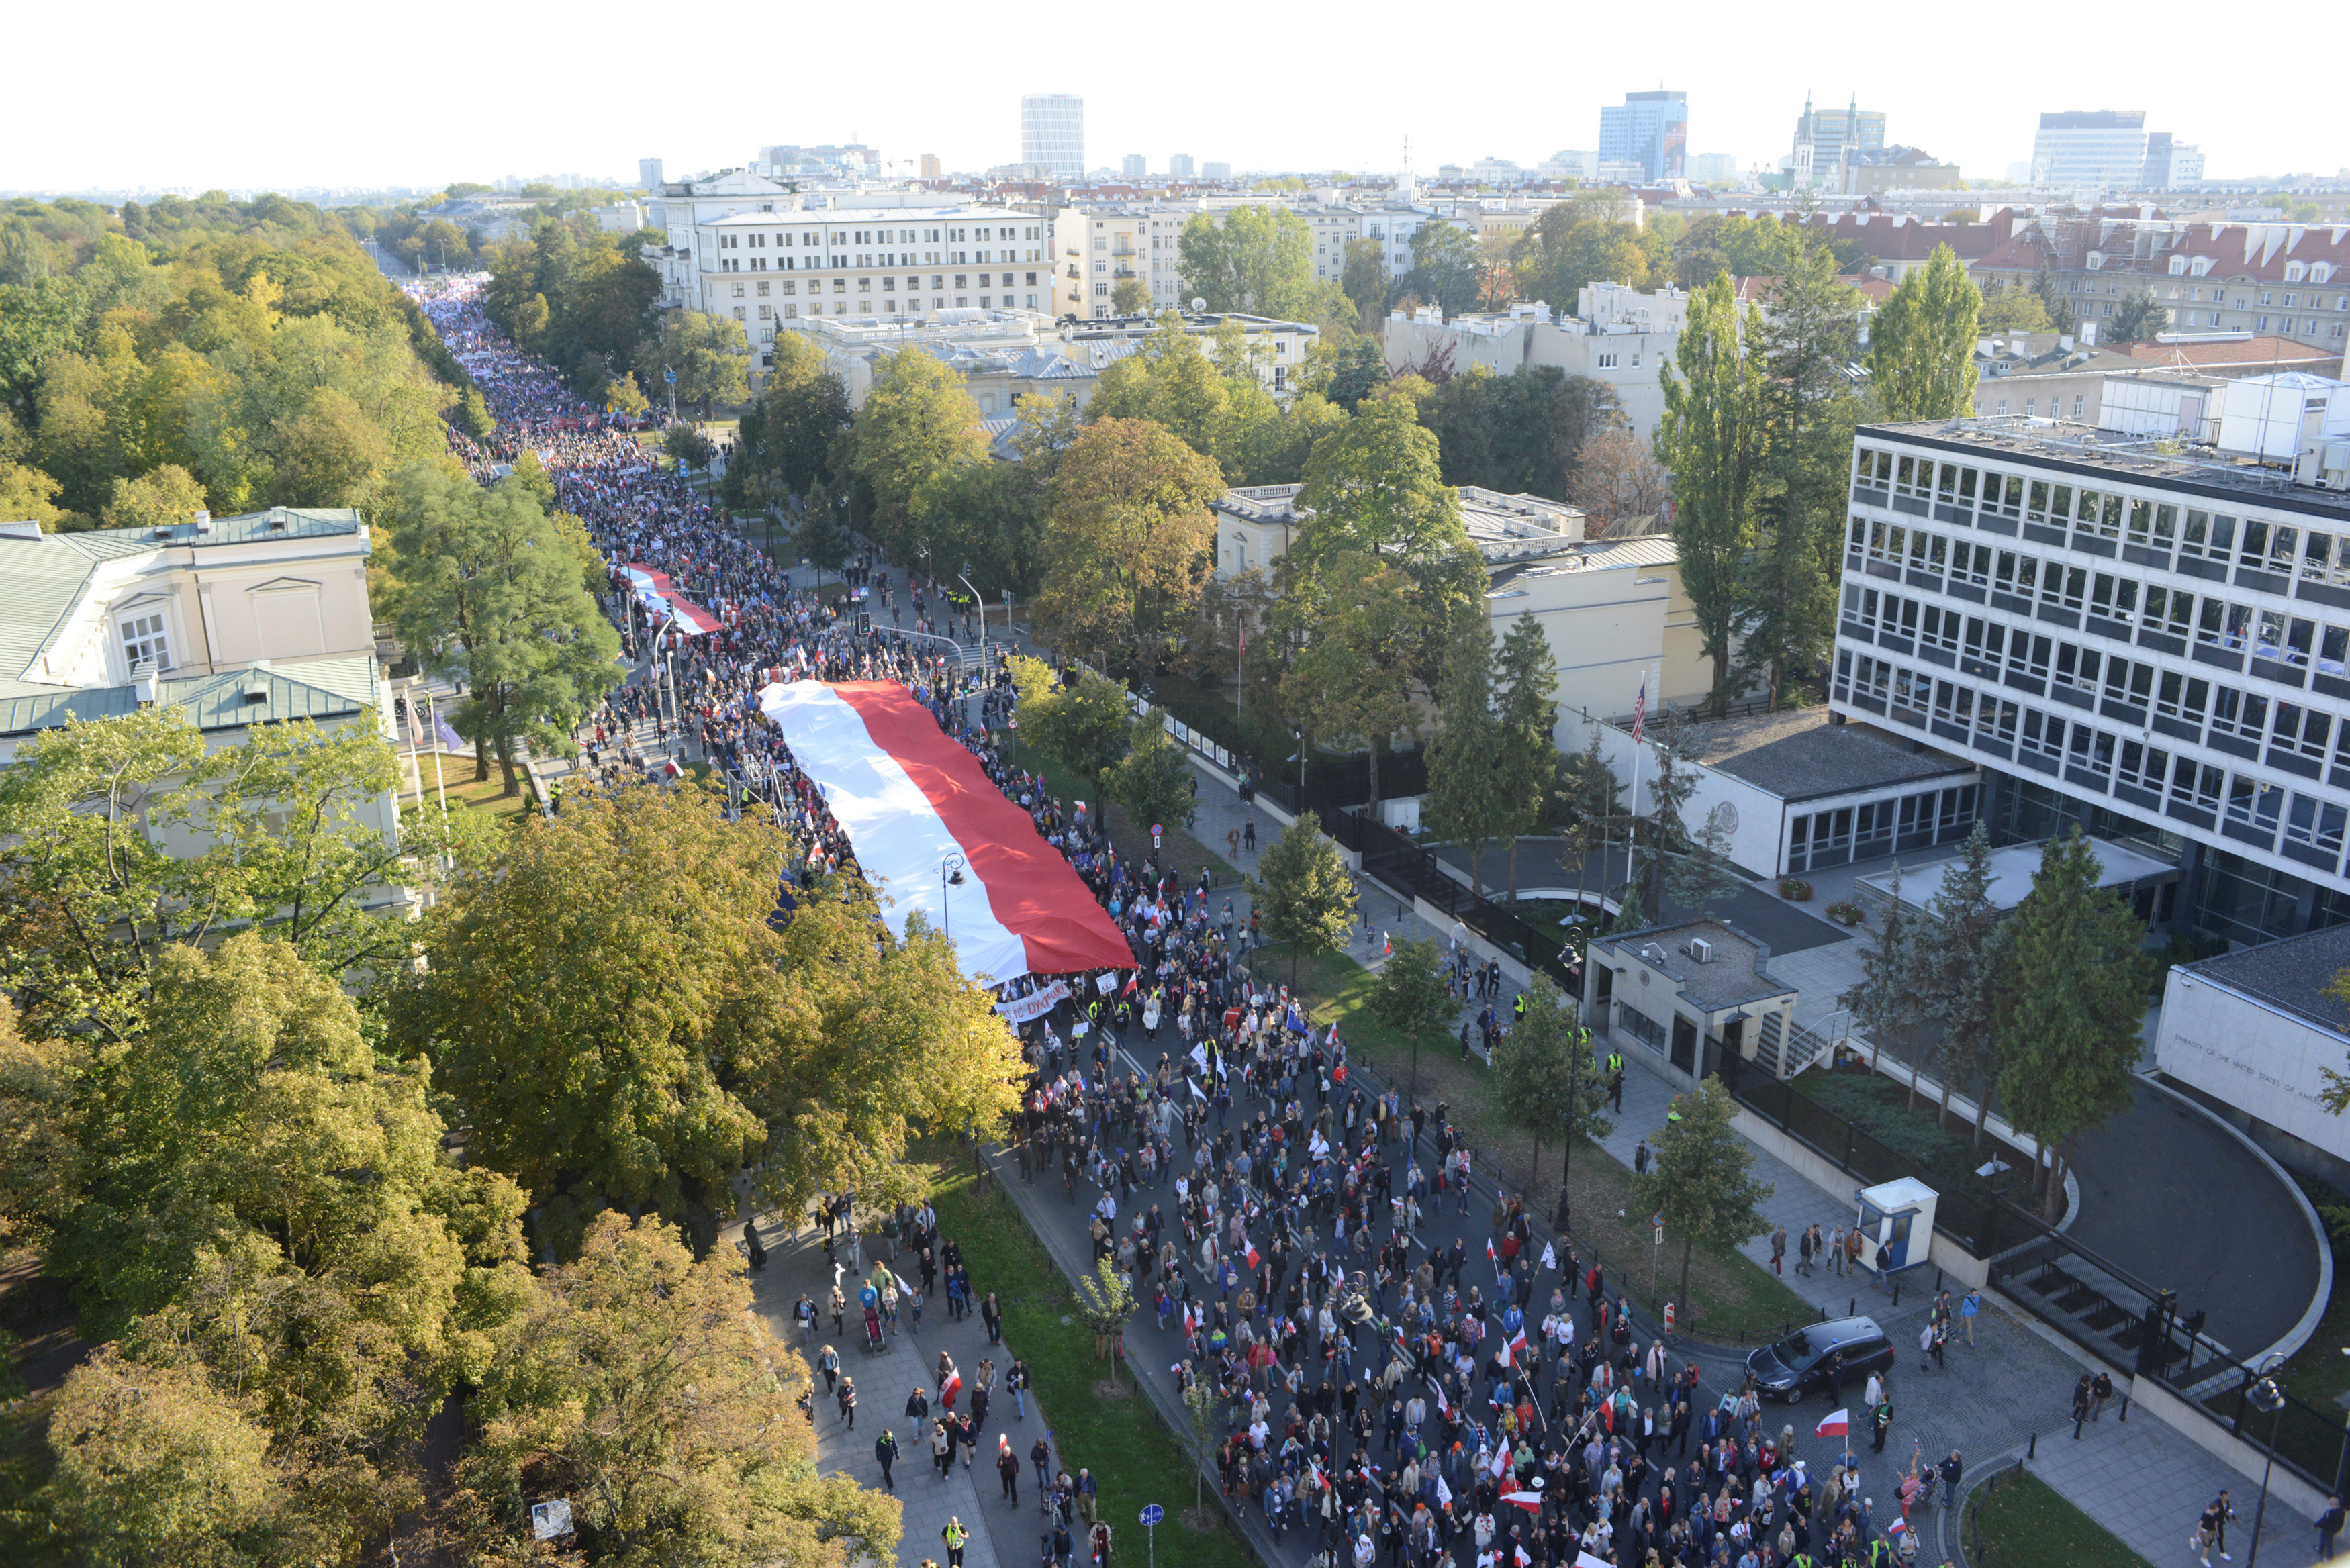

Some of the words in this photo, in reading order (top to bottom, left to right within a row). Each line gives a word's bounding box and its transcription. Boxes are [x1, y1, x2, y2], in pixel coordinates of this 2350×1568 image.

[2175, 1034, 2203, 1050] EMBASSY
[2206, 1048, 2216, 1056] OF
[2218, 1053, 2230, 1063] THE
[2232, 1060, 2255, 1075] UNITED
[2258, 1072, 2281, 1087] STATES
[2284, 1084, 2295, 1093] OF
